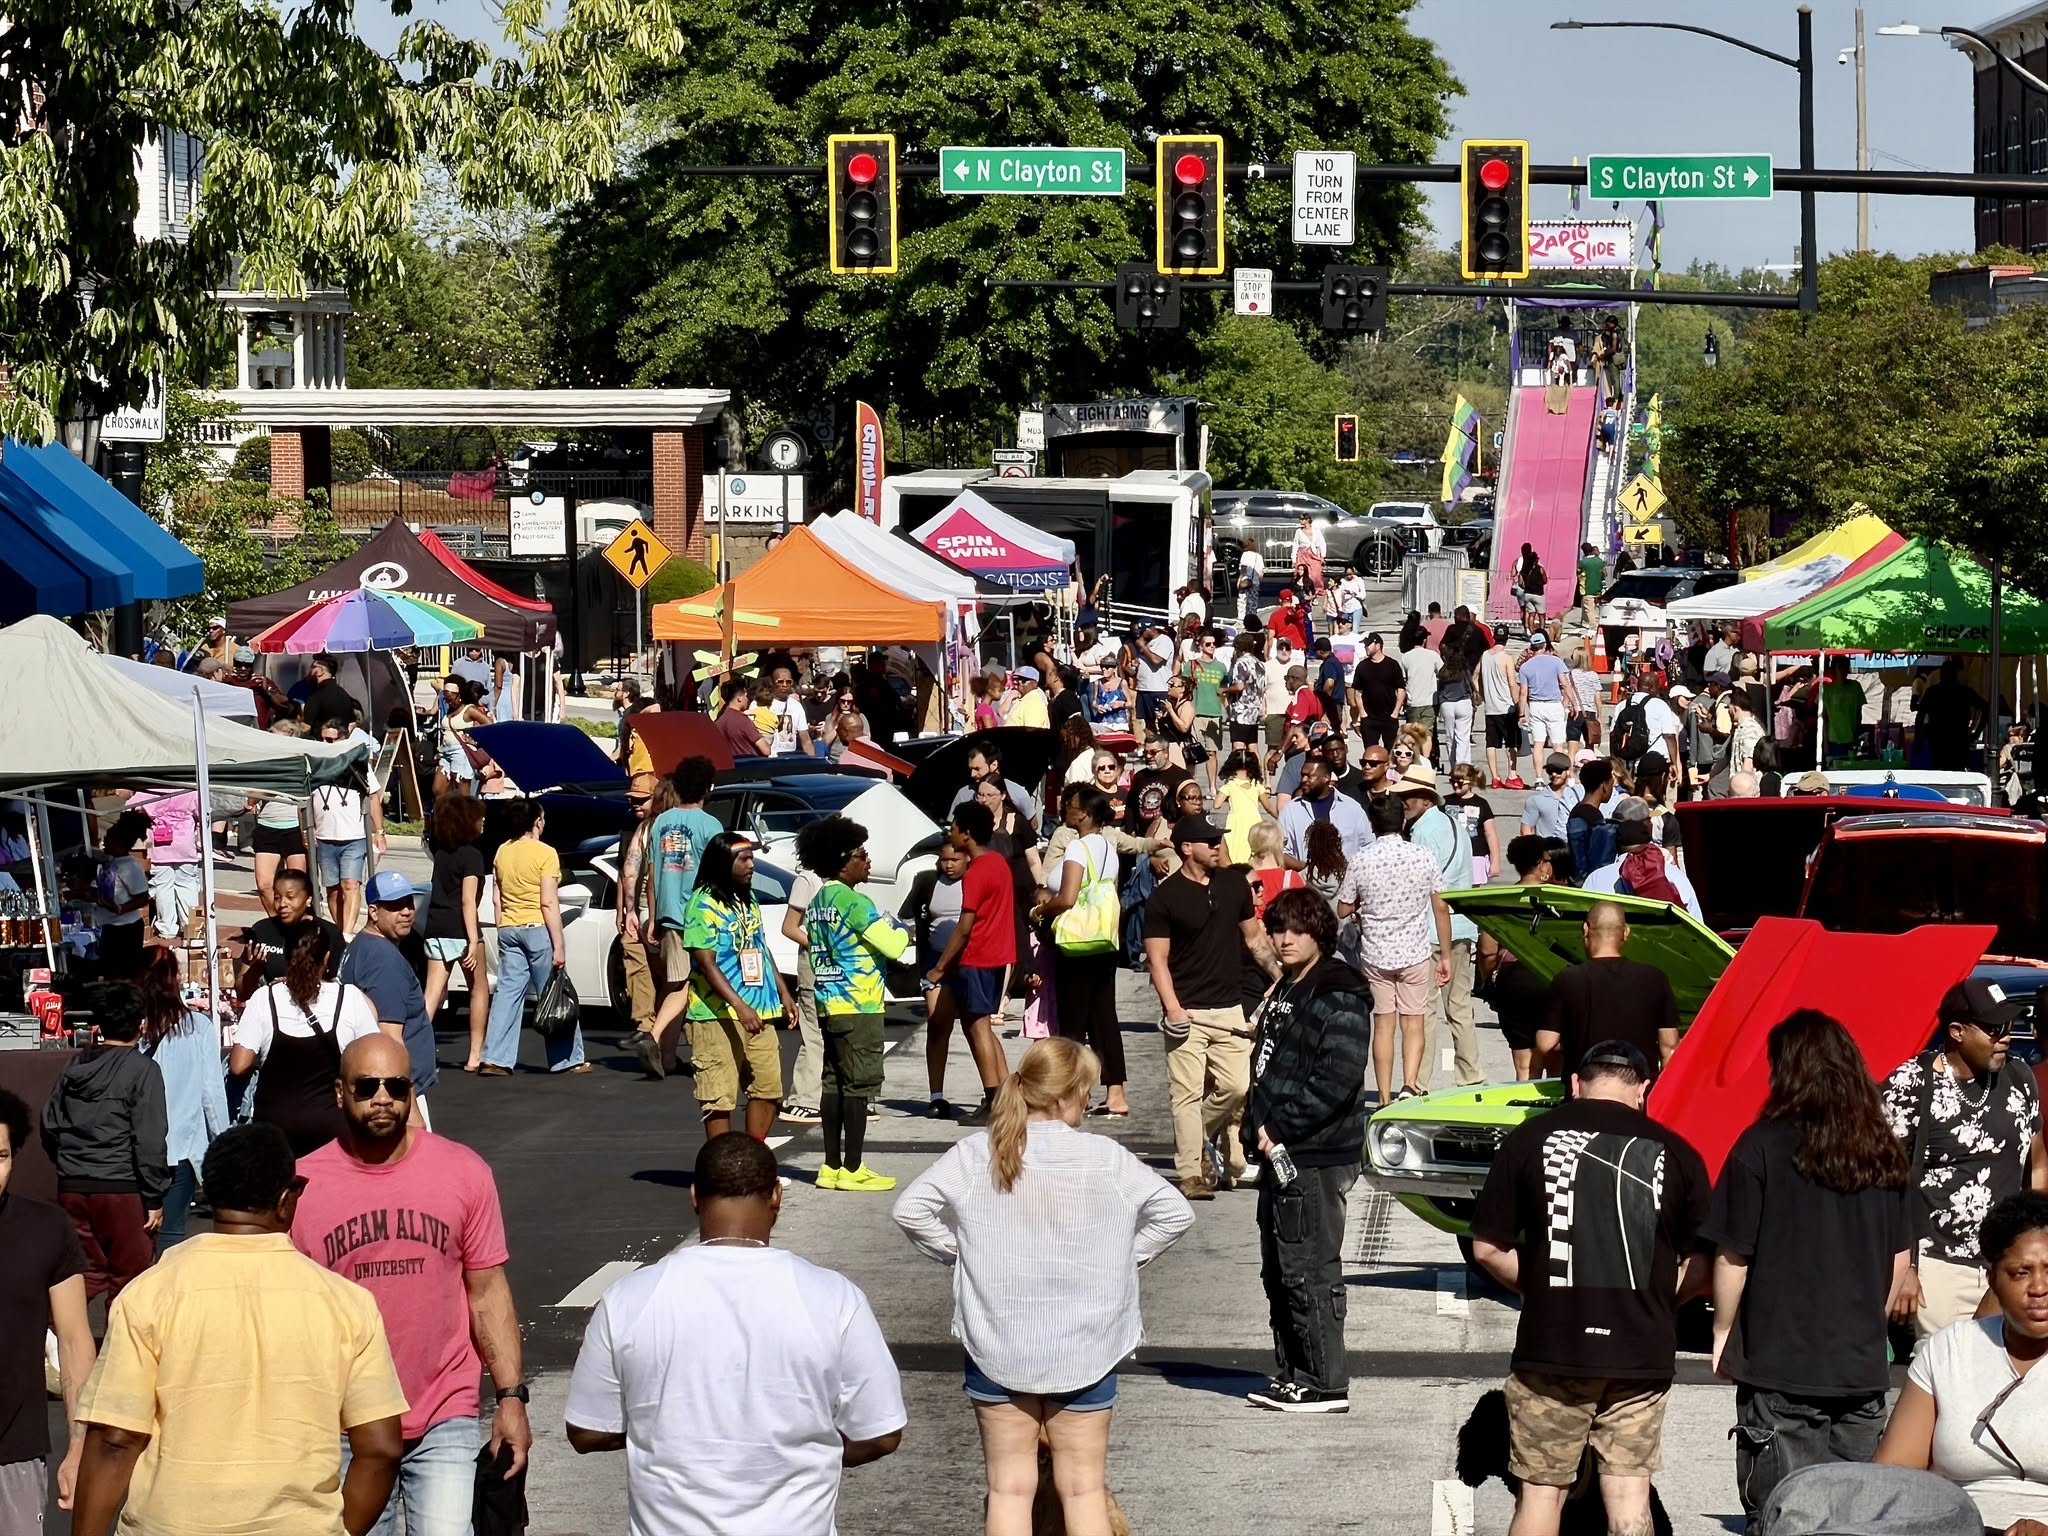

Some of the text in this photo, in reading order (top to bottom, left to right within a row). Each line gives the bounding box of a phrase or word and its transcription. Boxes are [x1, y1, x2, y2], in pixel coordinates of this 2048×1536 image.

[1315, 158, 1334, 172] NO
[977, 159, 1112, 188] N Clayton St
[1308, 174, 1343, 188] TURN
[1600, 165, 1735, 195] S Clayton St
[1306, 191, 1342, 204] FROM
[1298, 207, 1349, 220] CENTER
[1305, 223, 1341, 236] LANE
[1528, 226, 1589, 258] RAPID
[1568, 240, 1616, 266] SLIDE
[1243, 282, 1262, 291] STOP
[1240, 292, 1249, 300] ON
[1076, 404, 1149, 421] EIGHT ARMS
[105, 416, 159, 430] CROSSWALK
[780, 444, 790, 461] P
[936, 535, 993, 550] SPIN
[950, 547, 1007, 559] WIN!
[1924, 624, 1989, 640] cricket
[323, 1208, 450, 1269] DREAM ALIVE
[354, 1257, 425, 1280] UNIVERSITY
